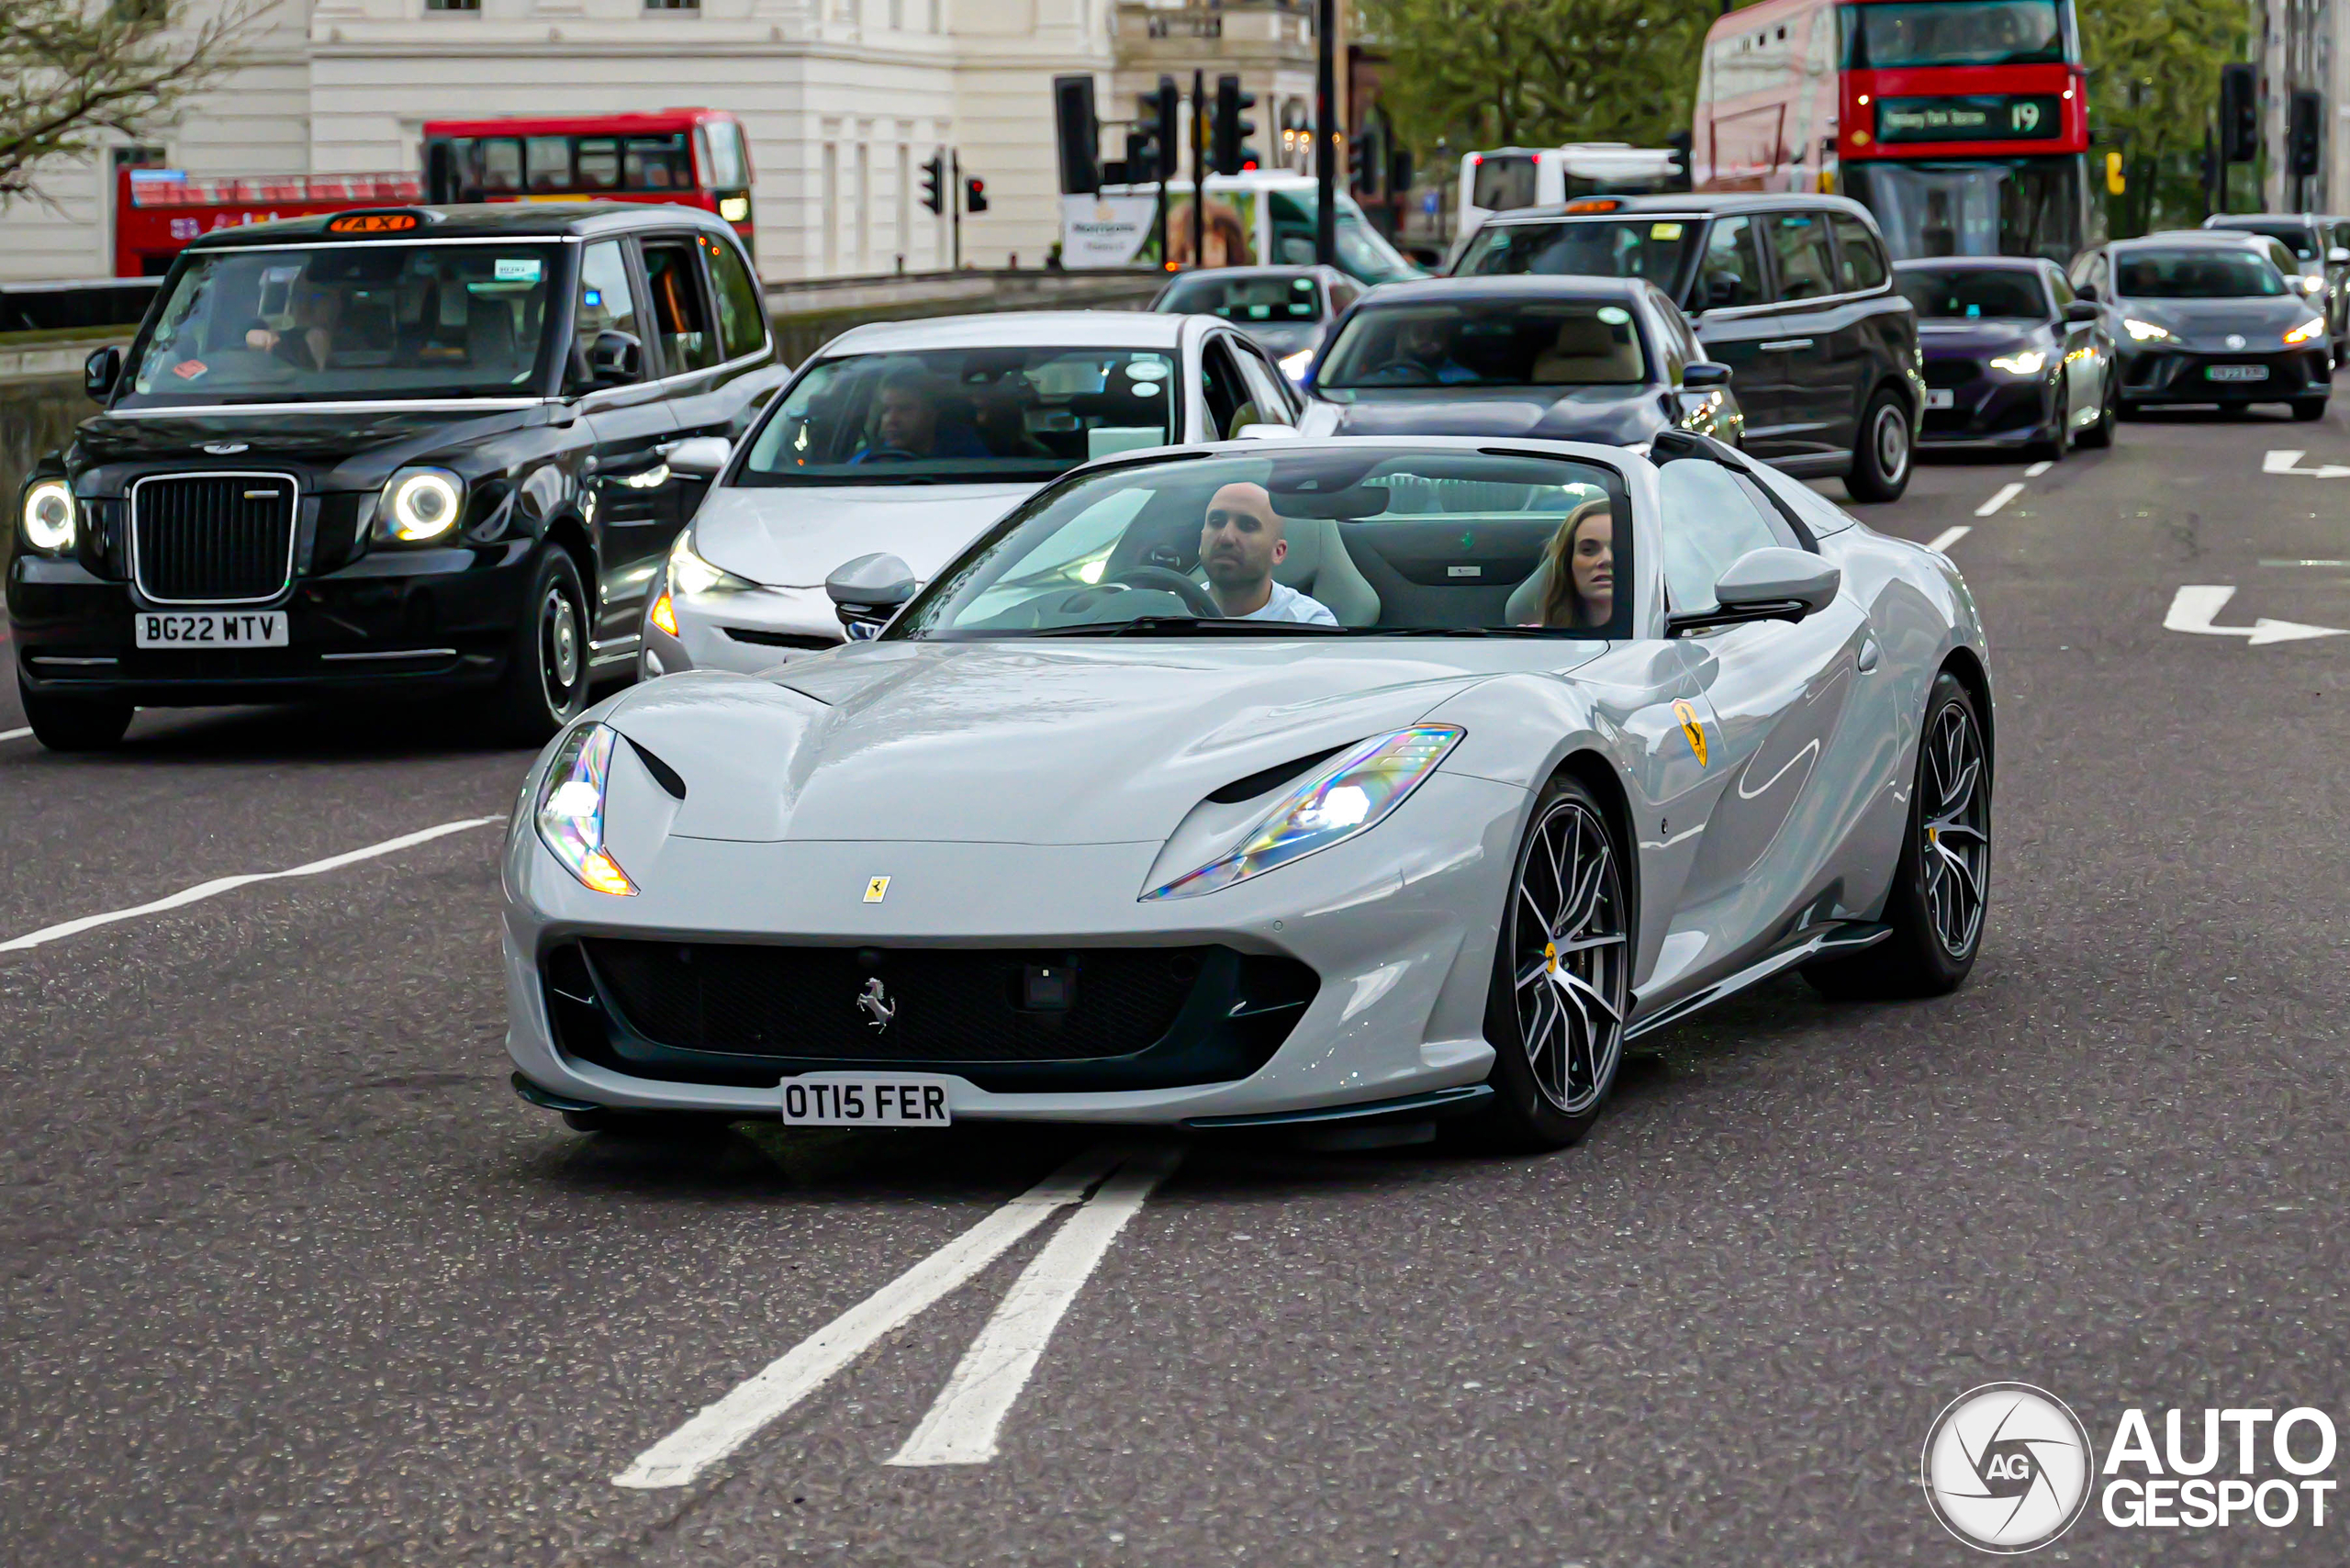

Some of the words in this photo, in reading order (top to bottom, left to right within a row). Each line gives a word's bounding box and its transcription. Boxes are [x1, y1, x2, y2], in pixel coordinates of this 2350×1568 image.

[2011, 102, 2040, 132] 19
[340, 216, 408, 230] TAXI
[146, 616, 214, 641] BG22
[223, 616, 274, 640] WTV
[875, 1085, 946, 1119] FER
